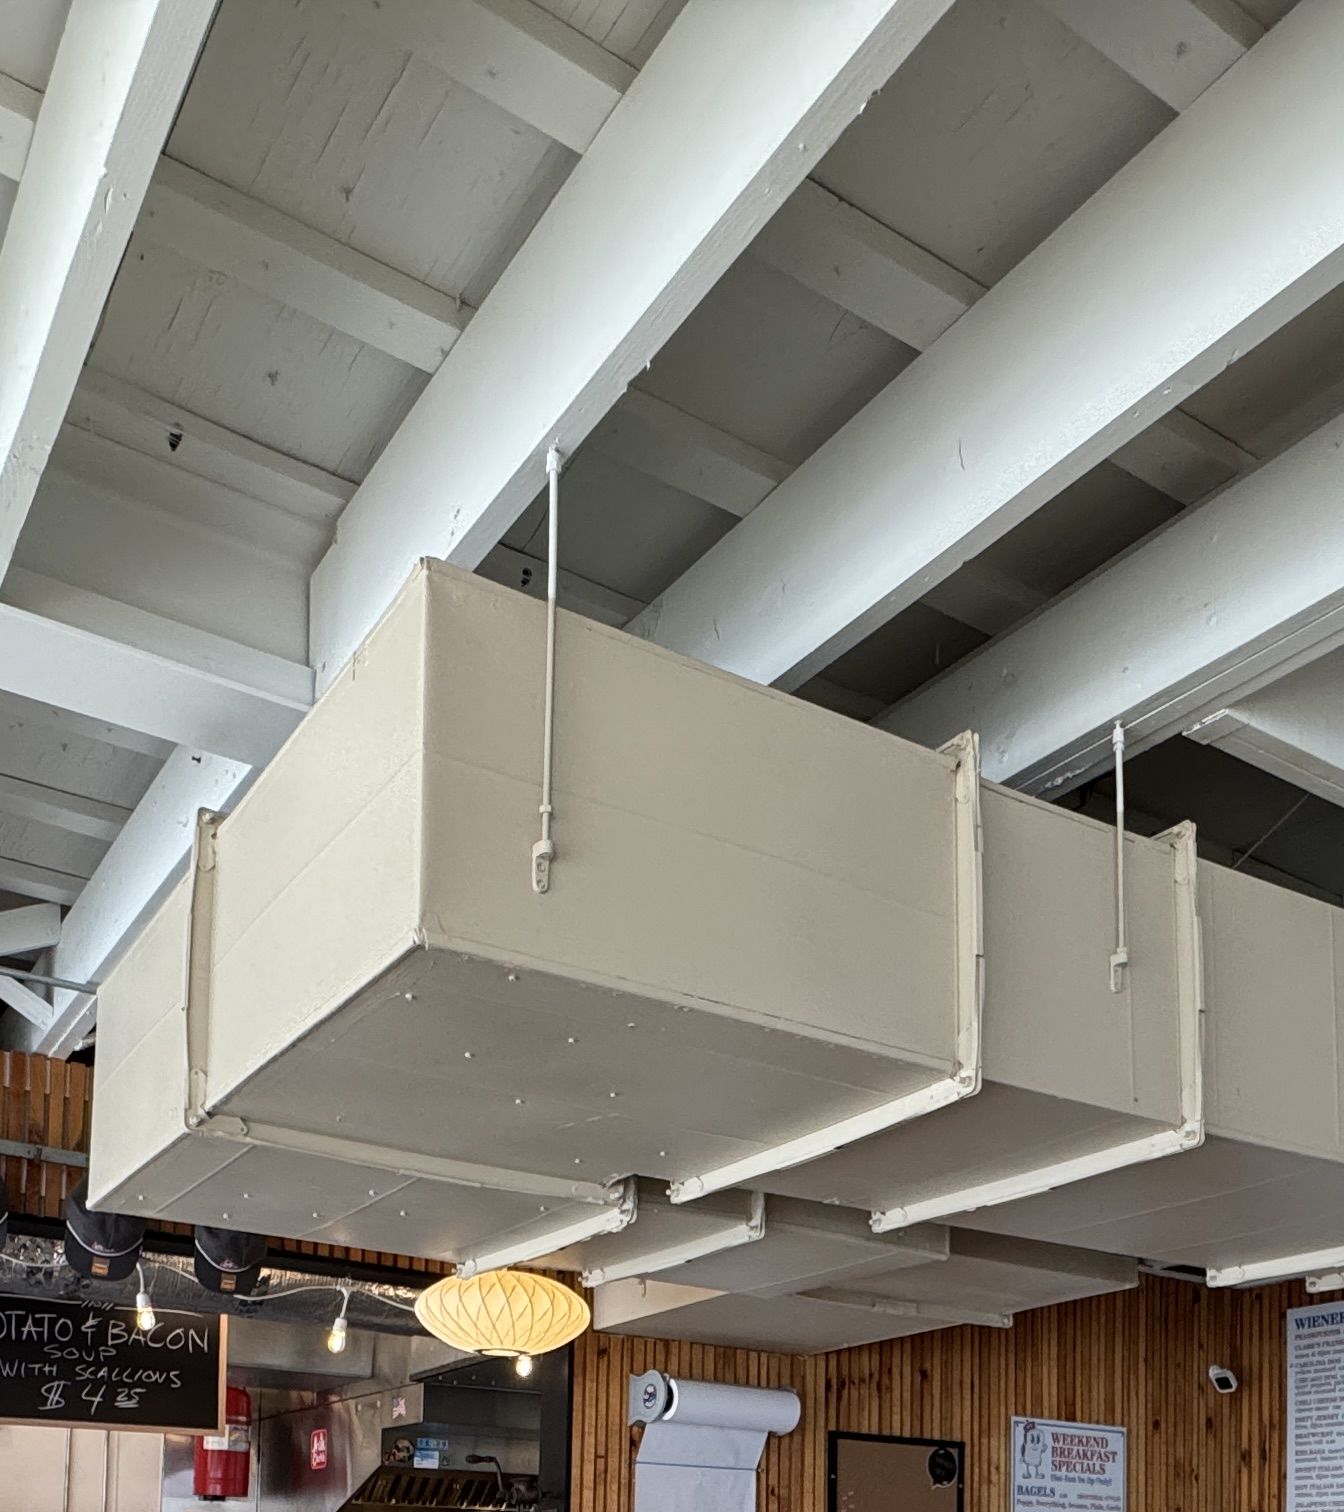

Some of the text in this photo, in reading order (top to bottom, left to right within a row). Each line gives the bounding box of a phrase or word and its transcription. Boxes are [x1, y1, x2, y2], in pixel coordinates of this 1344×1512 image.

[108, 1321, 209, 1353] BACON
[44, 1345, 117, 1360] SOUP
[0, 1359, 181, 1388] WITH SCALLIONS
[1051, 1432, 1108, 1449] WEEKEND
[1051, 1447, 1118, 1462] BREAKFAST
[1051, 1460, 1106, 1475] SPECIALS
[1017, 1485, 1056, 1497] BAGELS
